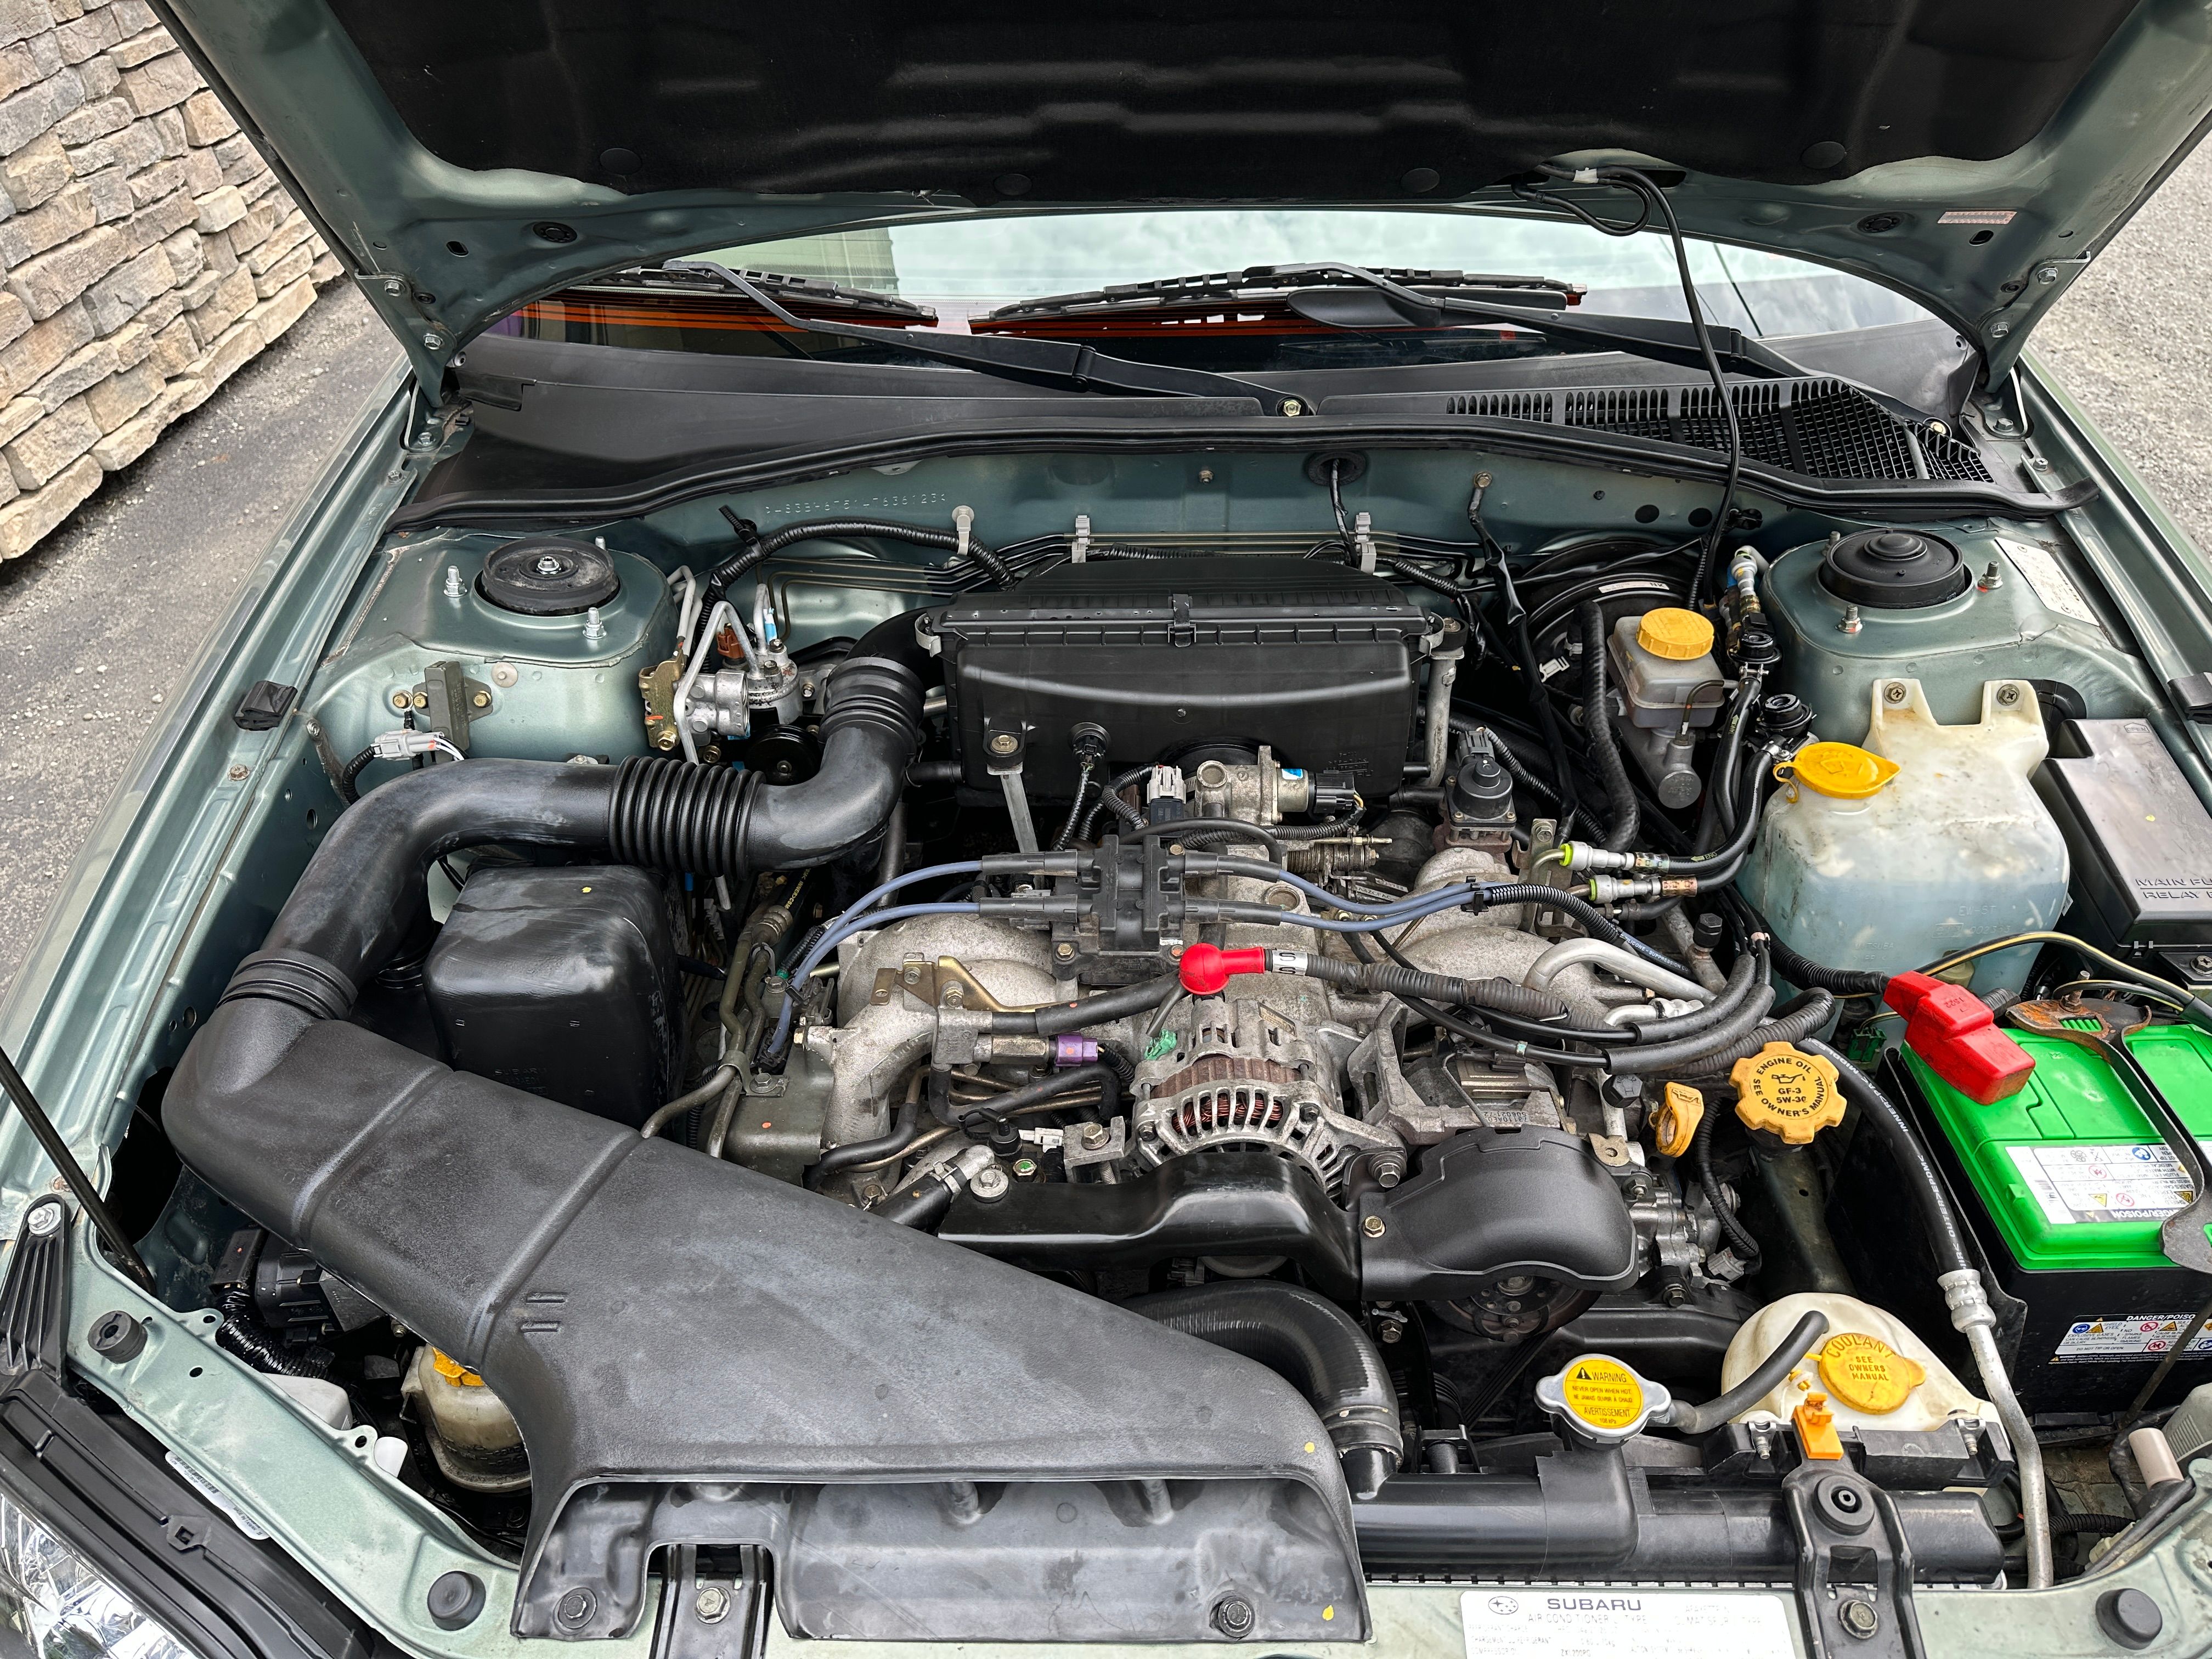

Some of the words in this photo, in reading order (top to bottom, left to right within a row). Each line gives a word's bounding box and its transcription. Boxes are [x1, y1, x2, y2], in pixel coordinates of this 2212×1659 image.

[1649, 950, 1681, 969] SUPPRESSION
[1757, 1058, 1792, 1075] ENGINE
[1796, 1060, 1811, 1074] OIL
[1753, 1078, 1763, 1096] SEE
[1761, 1098, 1809, 1116] OWNER'S
[1809, 1076, 1825, 1110] MANUAL
[1826, 1334, 1896, 1358] COOLANT
[1849, 1364, 1886, 1372] OWNERS
[1592, 1372, 1627, 1383] WARNING
[1584, 1407, 1630, 1417] AVERTISSEMENT
[1547, 1598, 1641, 1611] SUBARU
[1528, 1613, 1542, 1622] AIR
